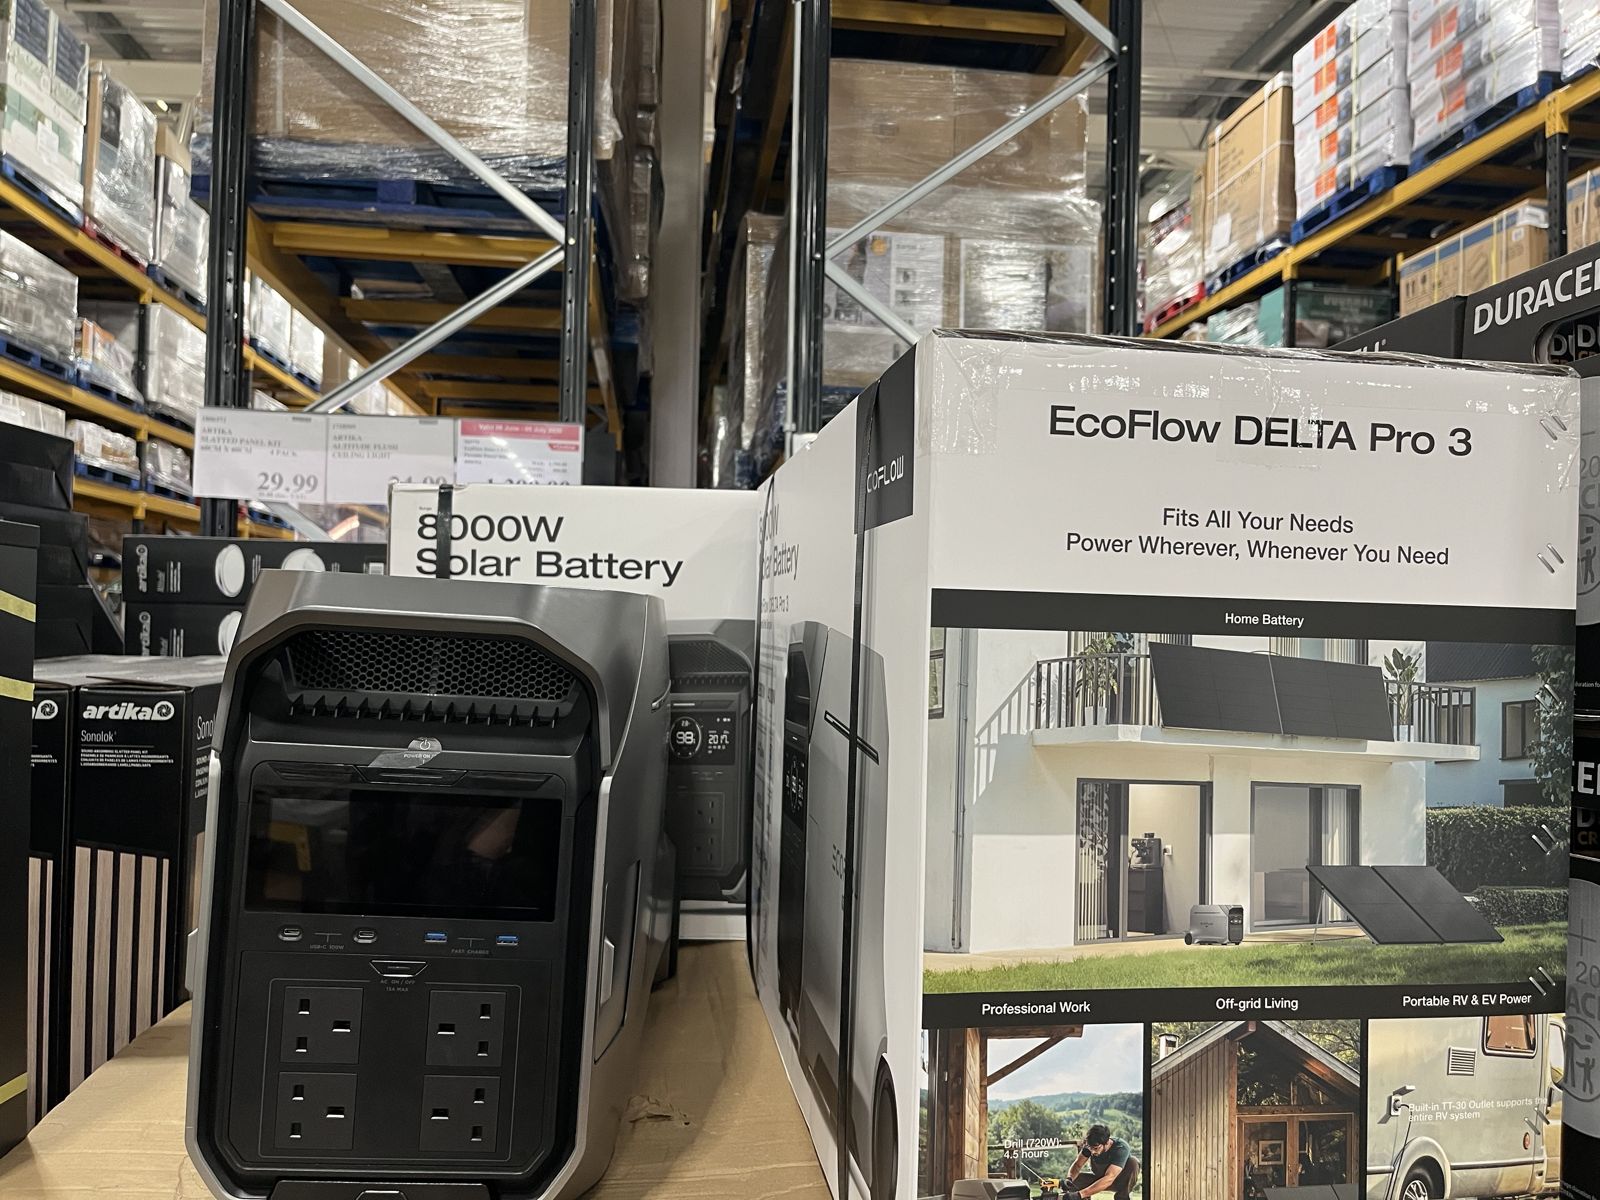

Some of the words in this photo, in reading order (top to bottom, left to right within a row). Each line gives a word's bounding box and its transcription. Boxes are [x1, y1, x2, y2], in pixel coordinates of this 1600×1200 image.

[1049, 405, 1221, 443] EcoFlow
[1234, 415, 1357, 451] DELTA
[1370, 423, 1435, 455] Pro
[1448, 427, 1472, 457] 3
[257, 472, 319, 494] 29.99
[417, 513, 564, 543] 8000W
[1163, 507, 1200, 527] Fits
[1205, 510, 1231, 528] All
[1238, 511, 1284, 531] Your
[1290, 513, 1354, 534] Needs
[1067, 532, 1133, 553] Power
[1138, 536, 1240, 560] Wherever,
[1247, 539, 1348, 561] Whenever
[1353, 544, 1390, 563] You
[1397, 546, 1449, 565] Need
[416, 547, 521, 578] Solar
[535, 551, 684, 588] Battery
[1225, 612, 1260, 625] Home
[1262, 613, 1305, 628] Battery
[83, 702, 153, 720] artika
[981, 1002, 1057, 1016] Professional
[1059, 1000, 1091, 1013] Work
[1215, 997, 1262, 1012] Off-grid
[1264, 997, 1299, 1012] Living
[1402, 995, 1450, 1008] Portable
[1452, 995, 1469, 1006] RV
[1470, 995, 1480, 1006] &
[1481, 994, 1497, 1005] EV
[1499, 993, 1532, 1005] Power
[1408, 1103, 1440, 1112] Built-in
[1442, 1101, 1467, 1111] TT-30
[1468, 1100, 1495, 1109] Outlet
[1496, 1098, 1533, 1108] supports
[1408, 1113, 1433, 1122] entire
[1435, 1112, 1449, 1120] RV
[1450, 1111, 1481, 1121] system
[1004, 1138, 1024, 1149] Drill
[1025, 1137, 1062, 1149] (720W):
[1003, 1149, 1019, 1159] 4.5
[1021, 1148, 1049, 1158] hours
